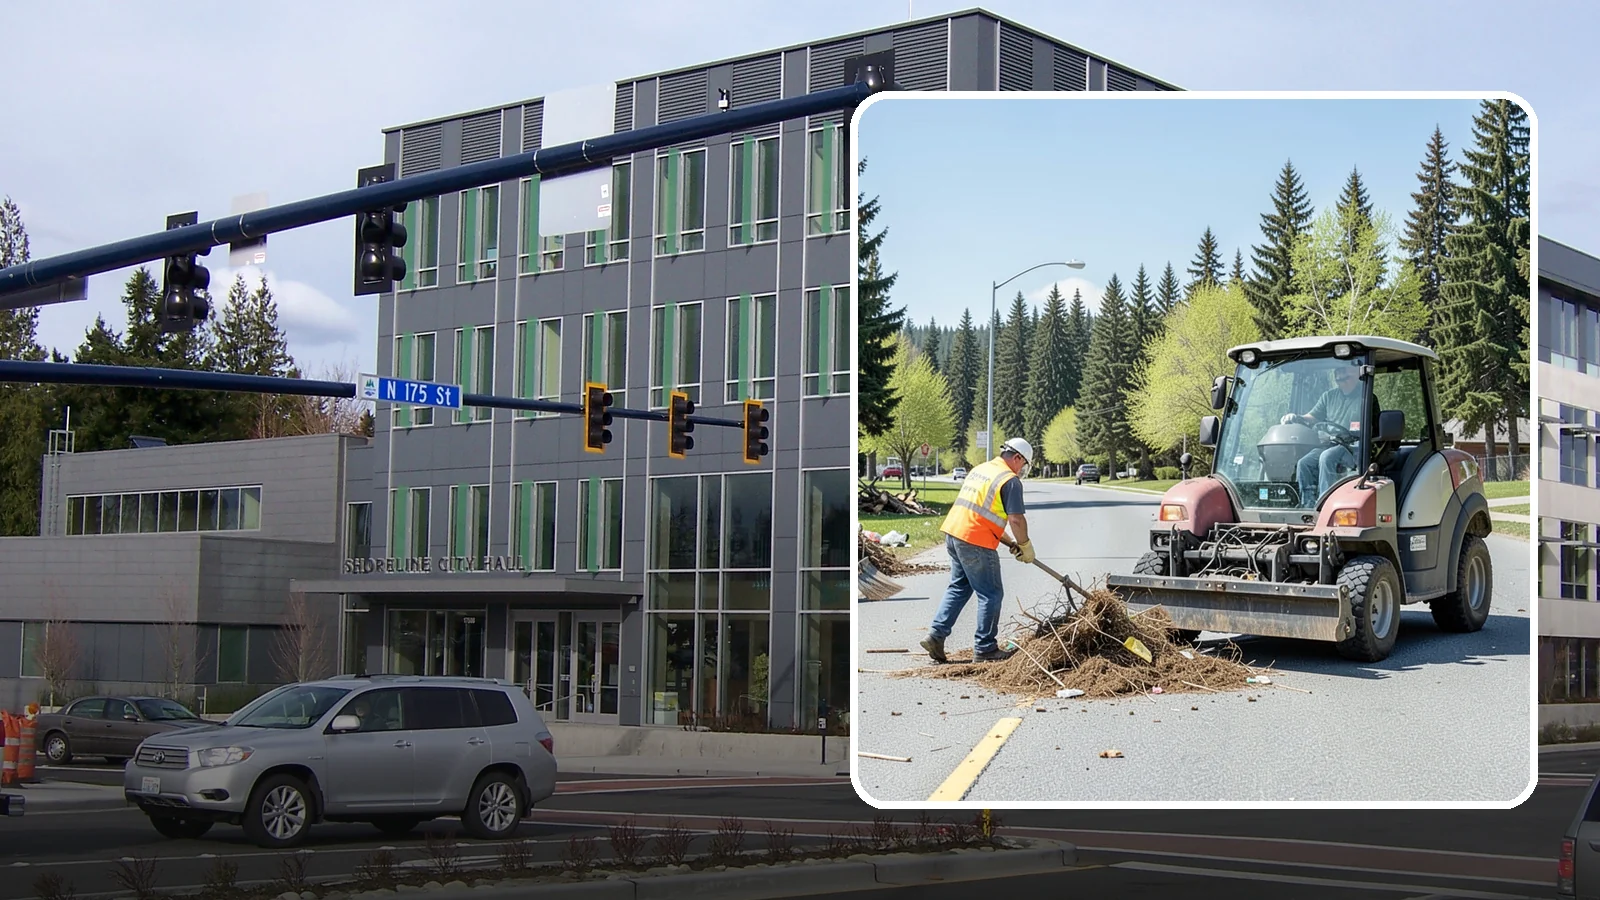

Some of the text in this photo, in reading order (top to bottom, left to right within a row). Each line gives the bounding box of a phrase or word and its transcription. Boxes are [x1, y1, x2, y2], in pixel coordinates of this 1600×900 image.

[387, 380, 451, 406] N 175 St
[344, 555, 525, 574] SHORELINE CITY HALL
